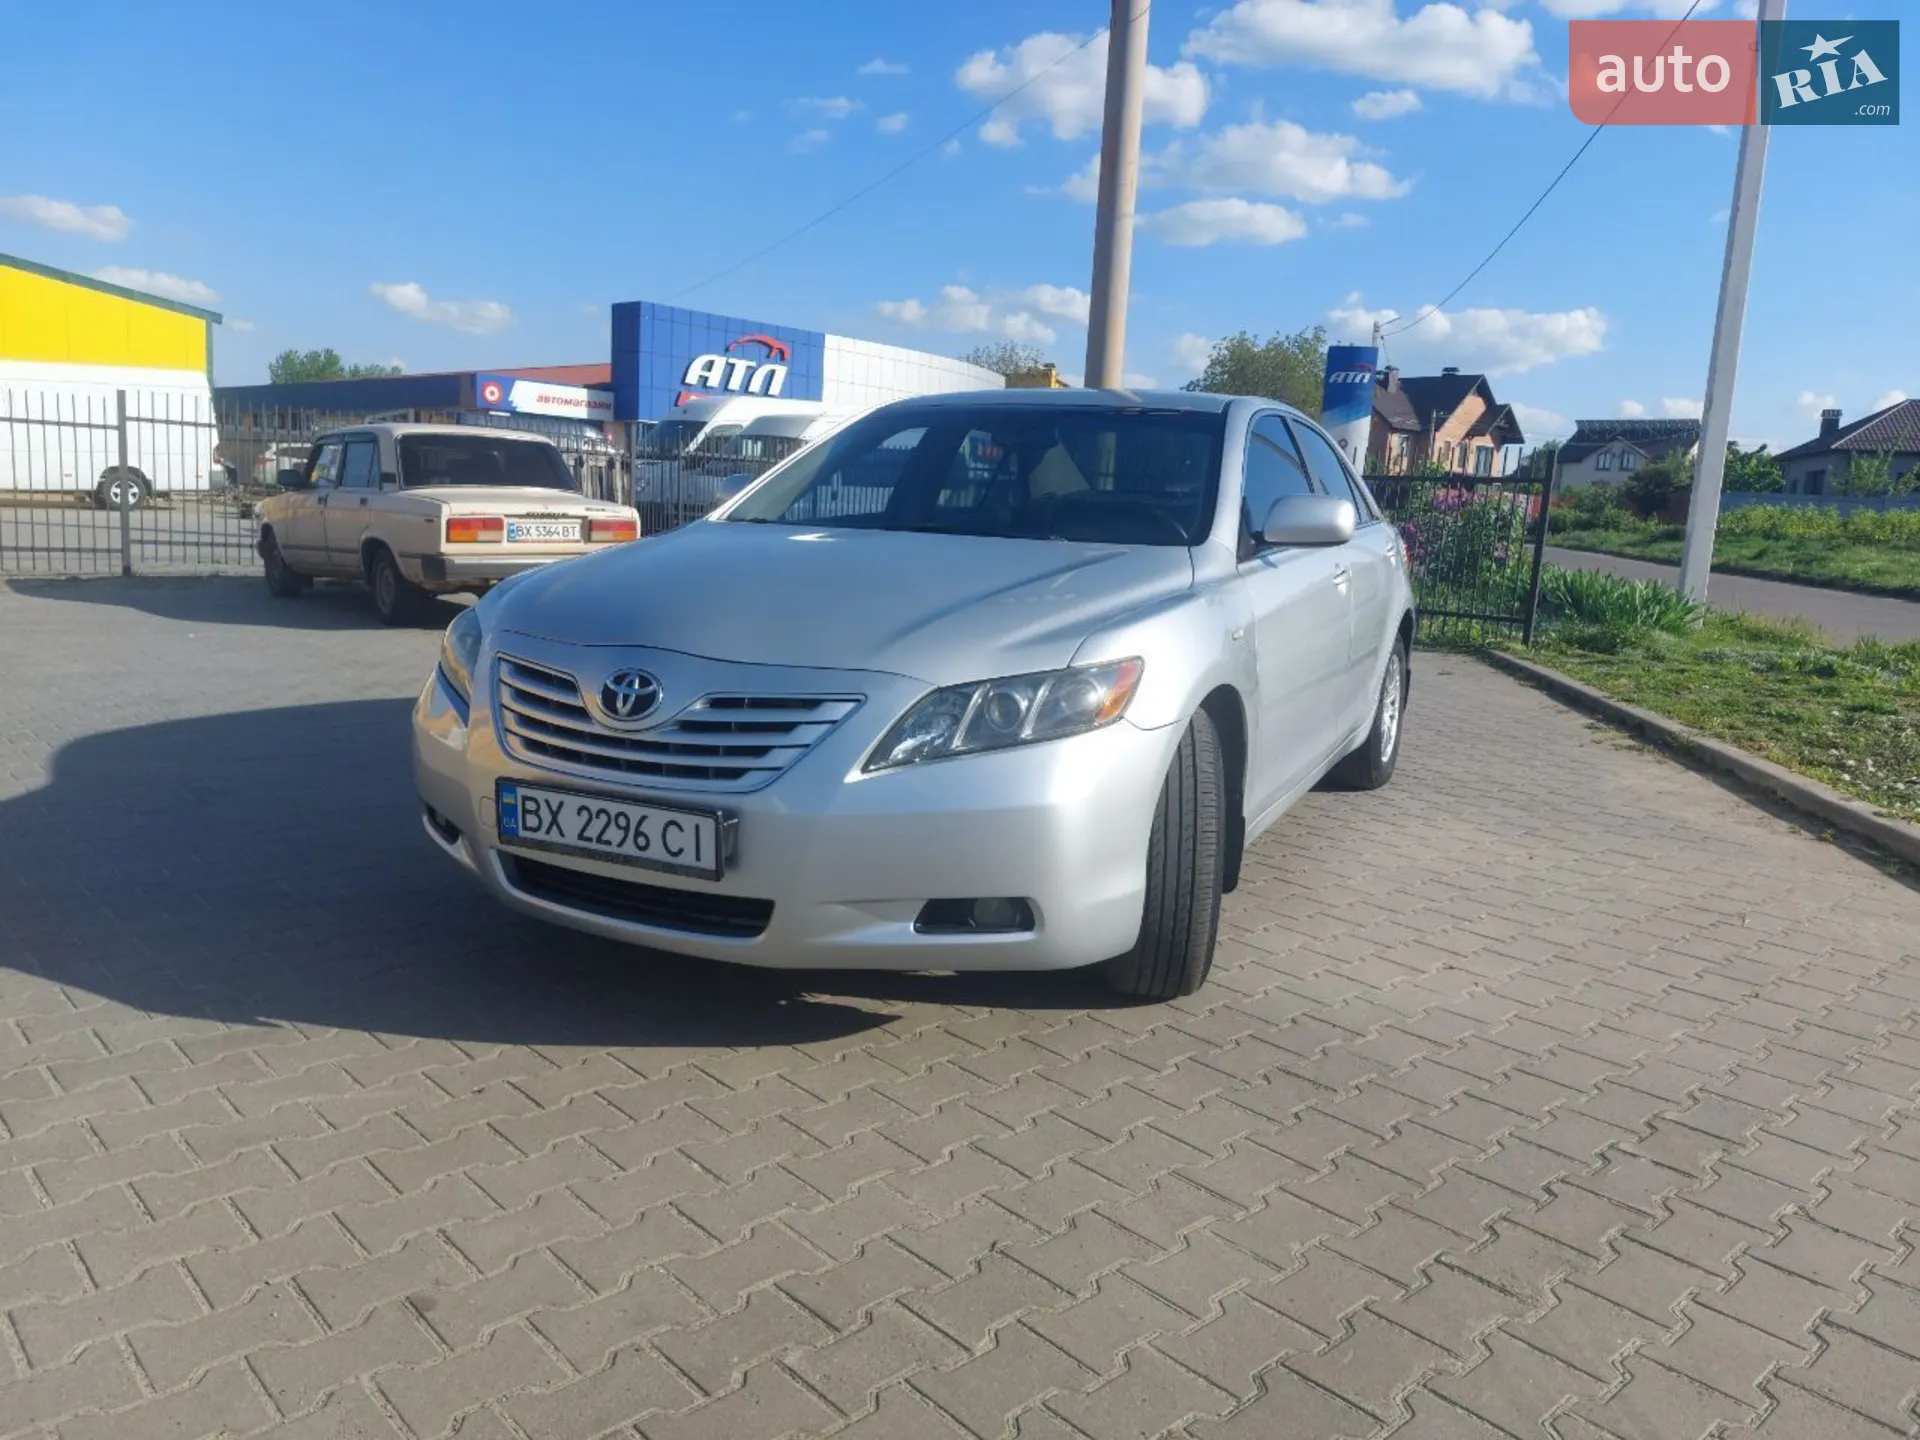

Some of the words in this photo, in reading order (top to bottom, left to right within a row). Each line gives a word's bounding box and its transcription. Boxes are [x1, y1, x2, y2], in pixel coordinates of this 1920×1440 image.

[535, 525, 560, 538] 5364
[520, 795, 566, 838] BX
[576, 804, 651, 852] 2296
